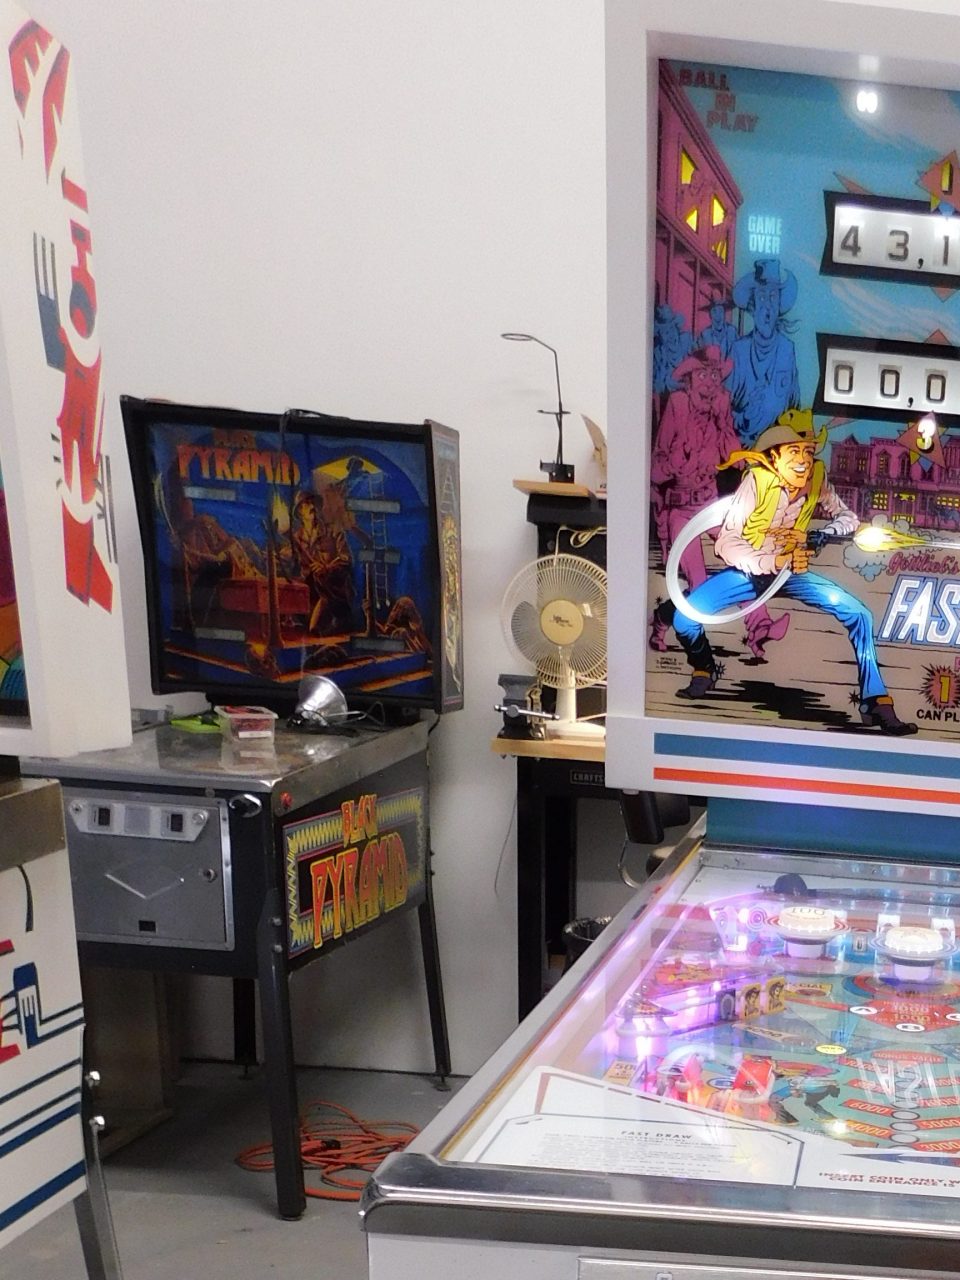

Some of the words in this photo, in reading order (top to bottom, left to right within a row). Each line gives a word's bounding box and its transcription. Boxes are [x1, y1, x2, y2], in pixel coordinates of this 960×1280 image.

[679, 69, 730, 92] BALL
[706, 110, 759, 133] PLAY
[748, 215, 782, 236] GAME
[749, 234, 781, 254] OVER
[886, 551, 960, 577] Gottlieb's
[940, 674, 951, 704] 1
[916, 709, 942, 722] CAN
[341, 794, 378, 848] BLACK
[310, 831, 409, 949] PYRAMID
[850, 1102, 888, 1113] 6000
[923, 1119, 960, 1128] 5000
[819, 1172, 864, 1180] INSERT
[909, 1177, 944, 1185] ONLY
[868, 1178, 938, 1187] ENTRANCE
